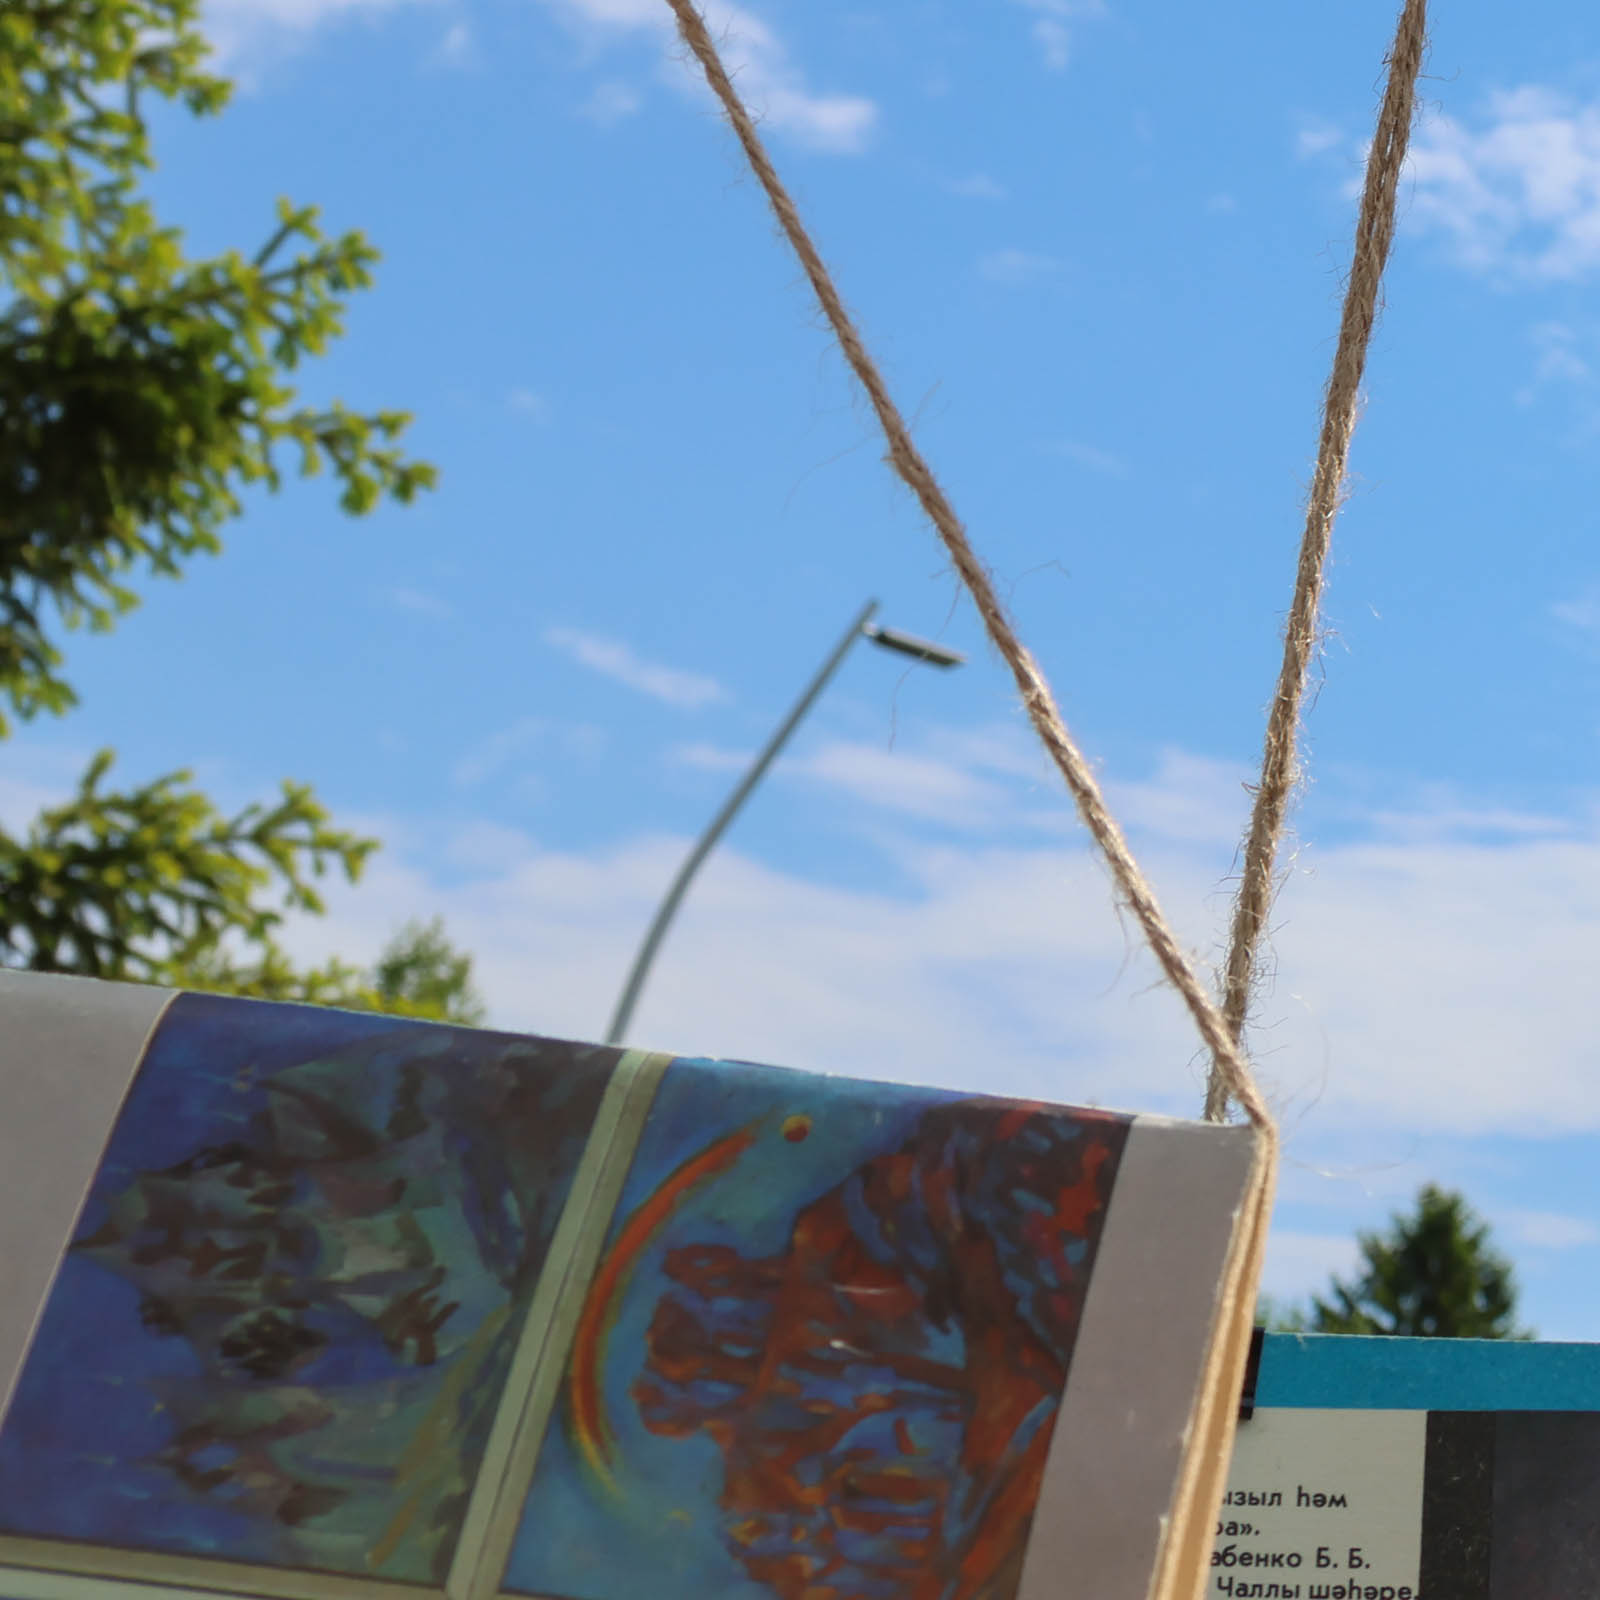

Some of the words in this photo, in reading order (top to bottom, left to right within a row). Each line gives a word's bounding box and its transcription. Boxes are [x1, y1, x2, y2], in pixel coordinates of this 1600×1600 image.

[1295, 1484, 1348, 1508] һәм
[1315, 1546, 1339, 1569] Б.
[1347, 1547, 1371, 1569] Б.
[1217, 1576, 1301, 1599] Чаллы
